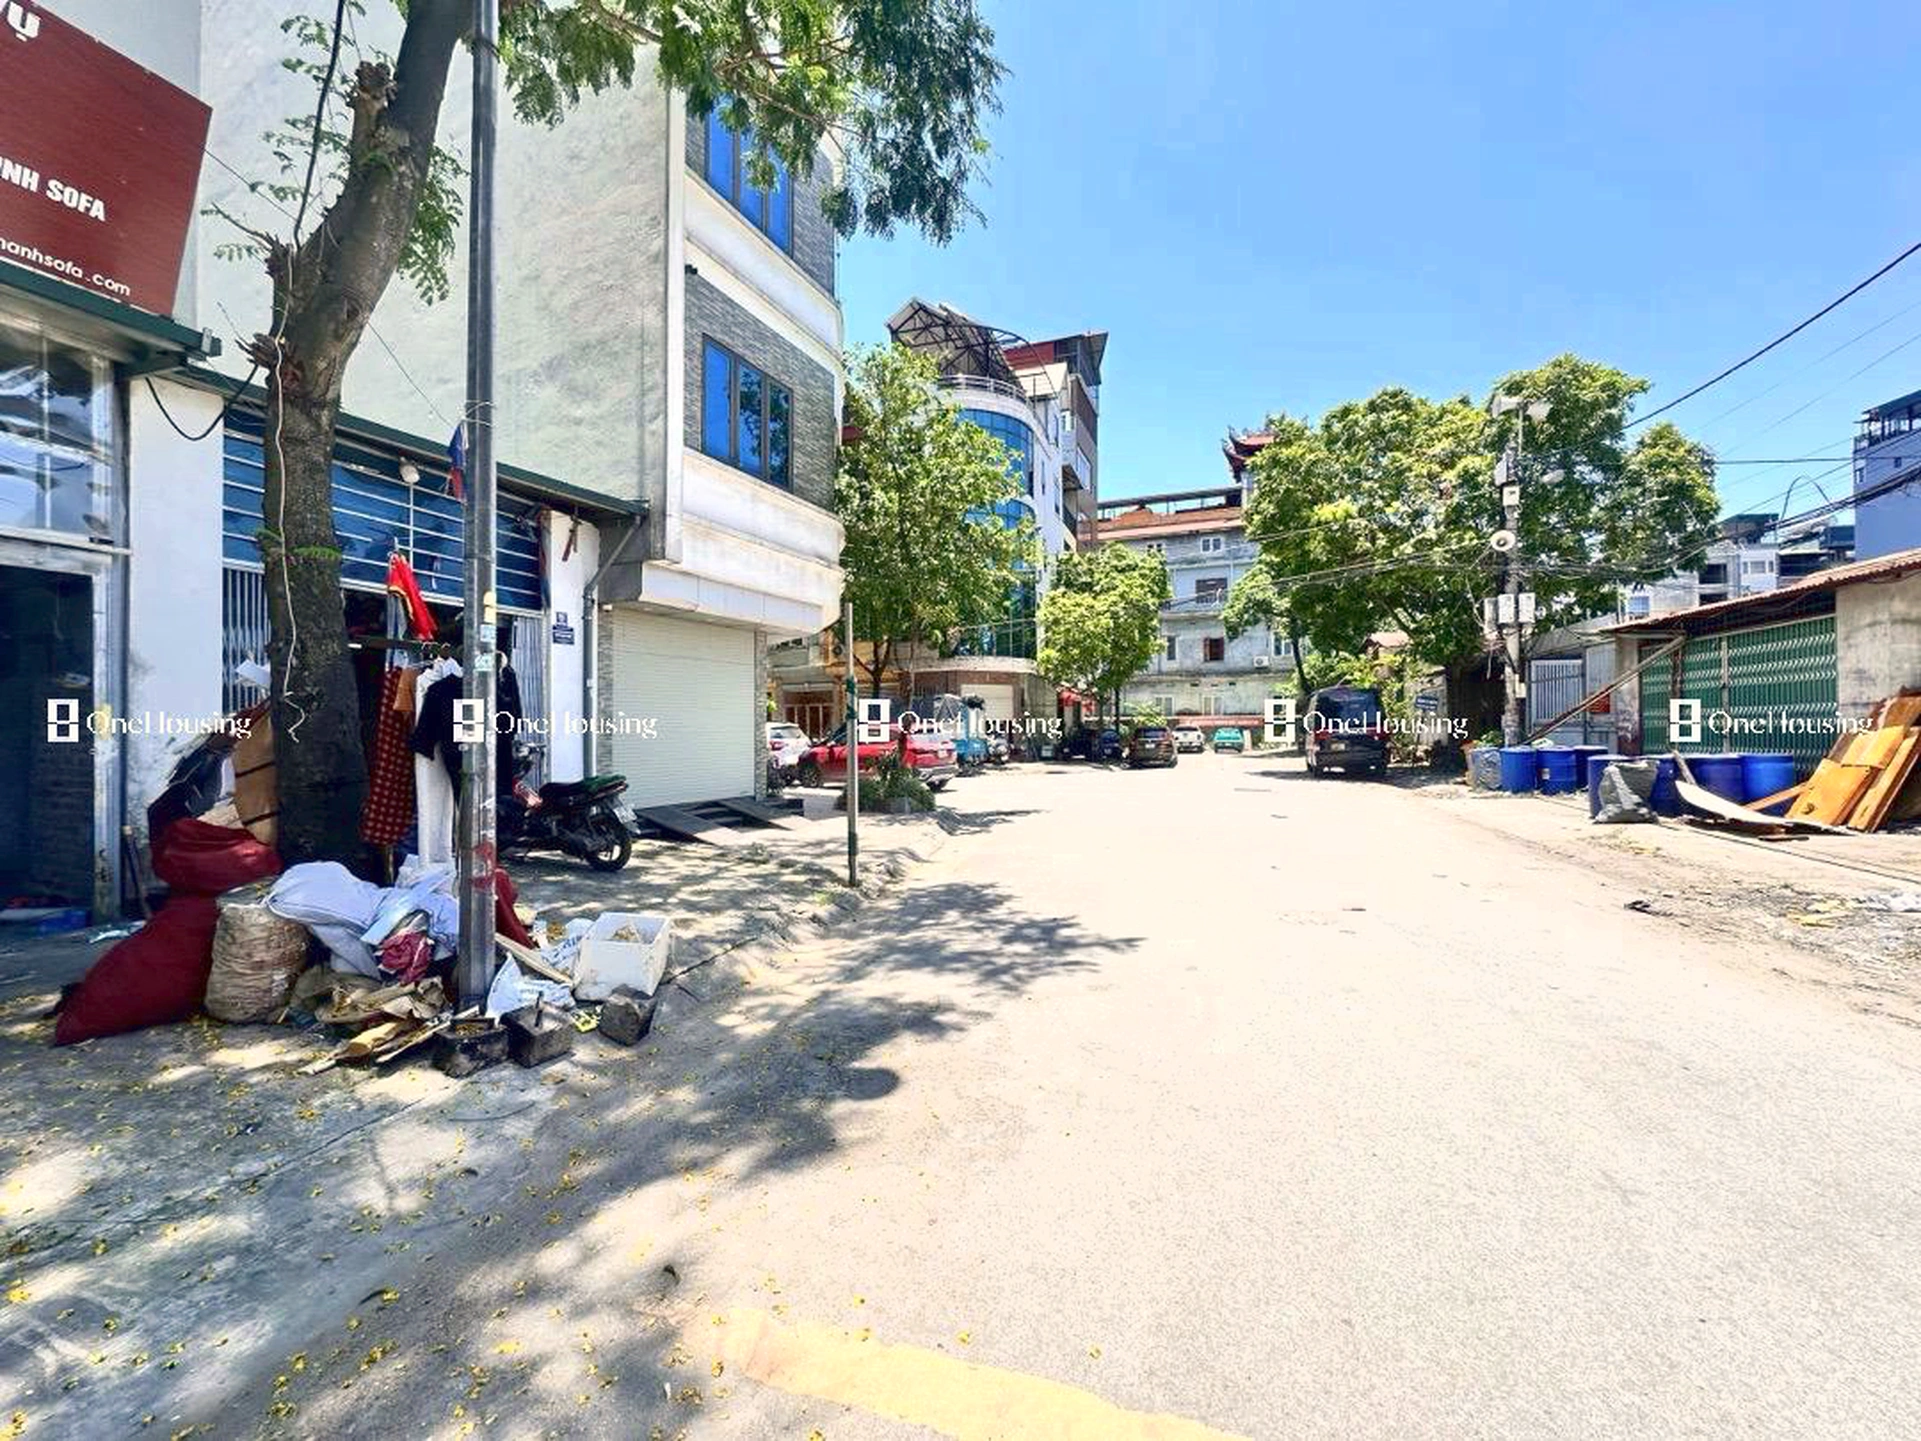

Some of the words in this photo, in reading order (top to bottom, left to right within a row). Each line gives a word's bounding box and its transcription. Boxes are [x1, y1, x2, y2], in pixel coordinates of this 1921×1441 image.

[0, 0, 41, 42] Ụ
[0, 156, 40, 192] NH
[46, 179, 106, 221] SOFA
